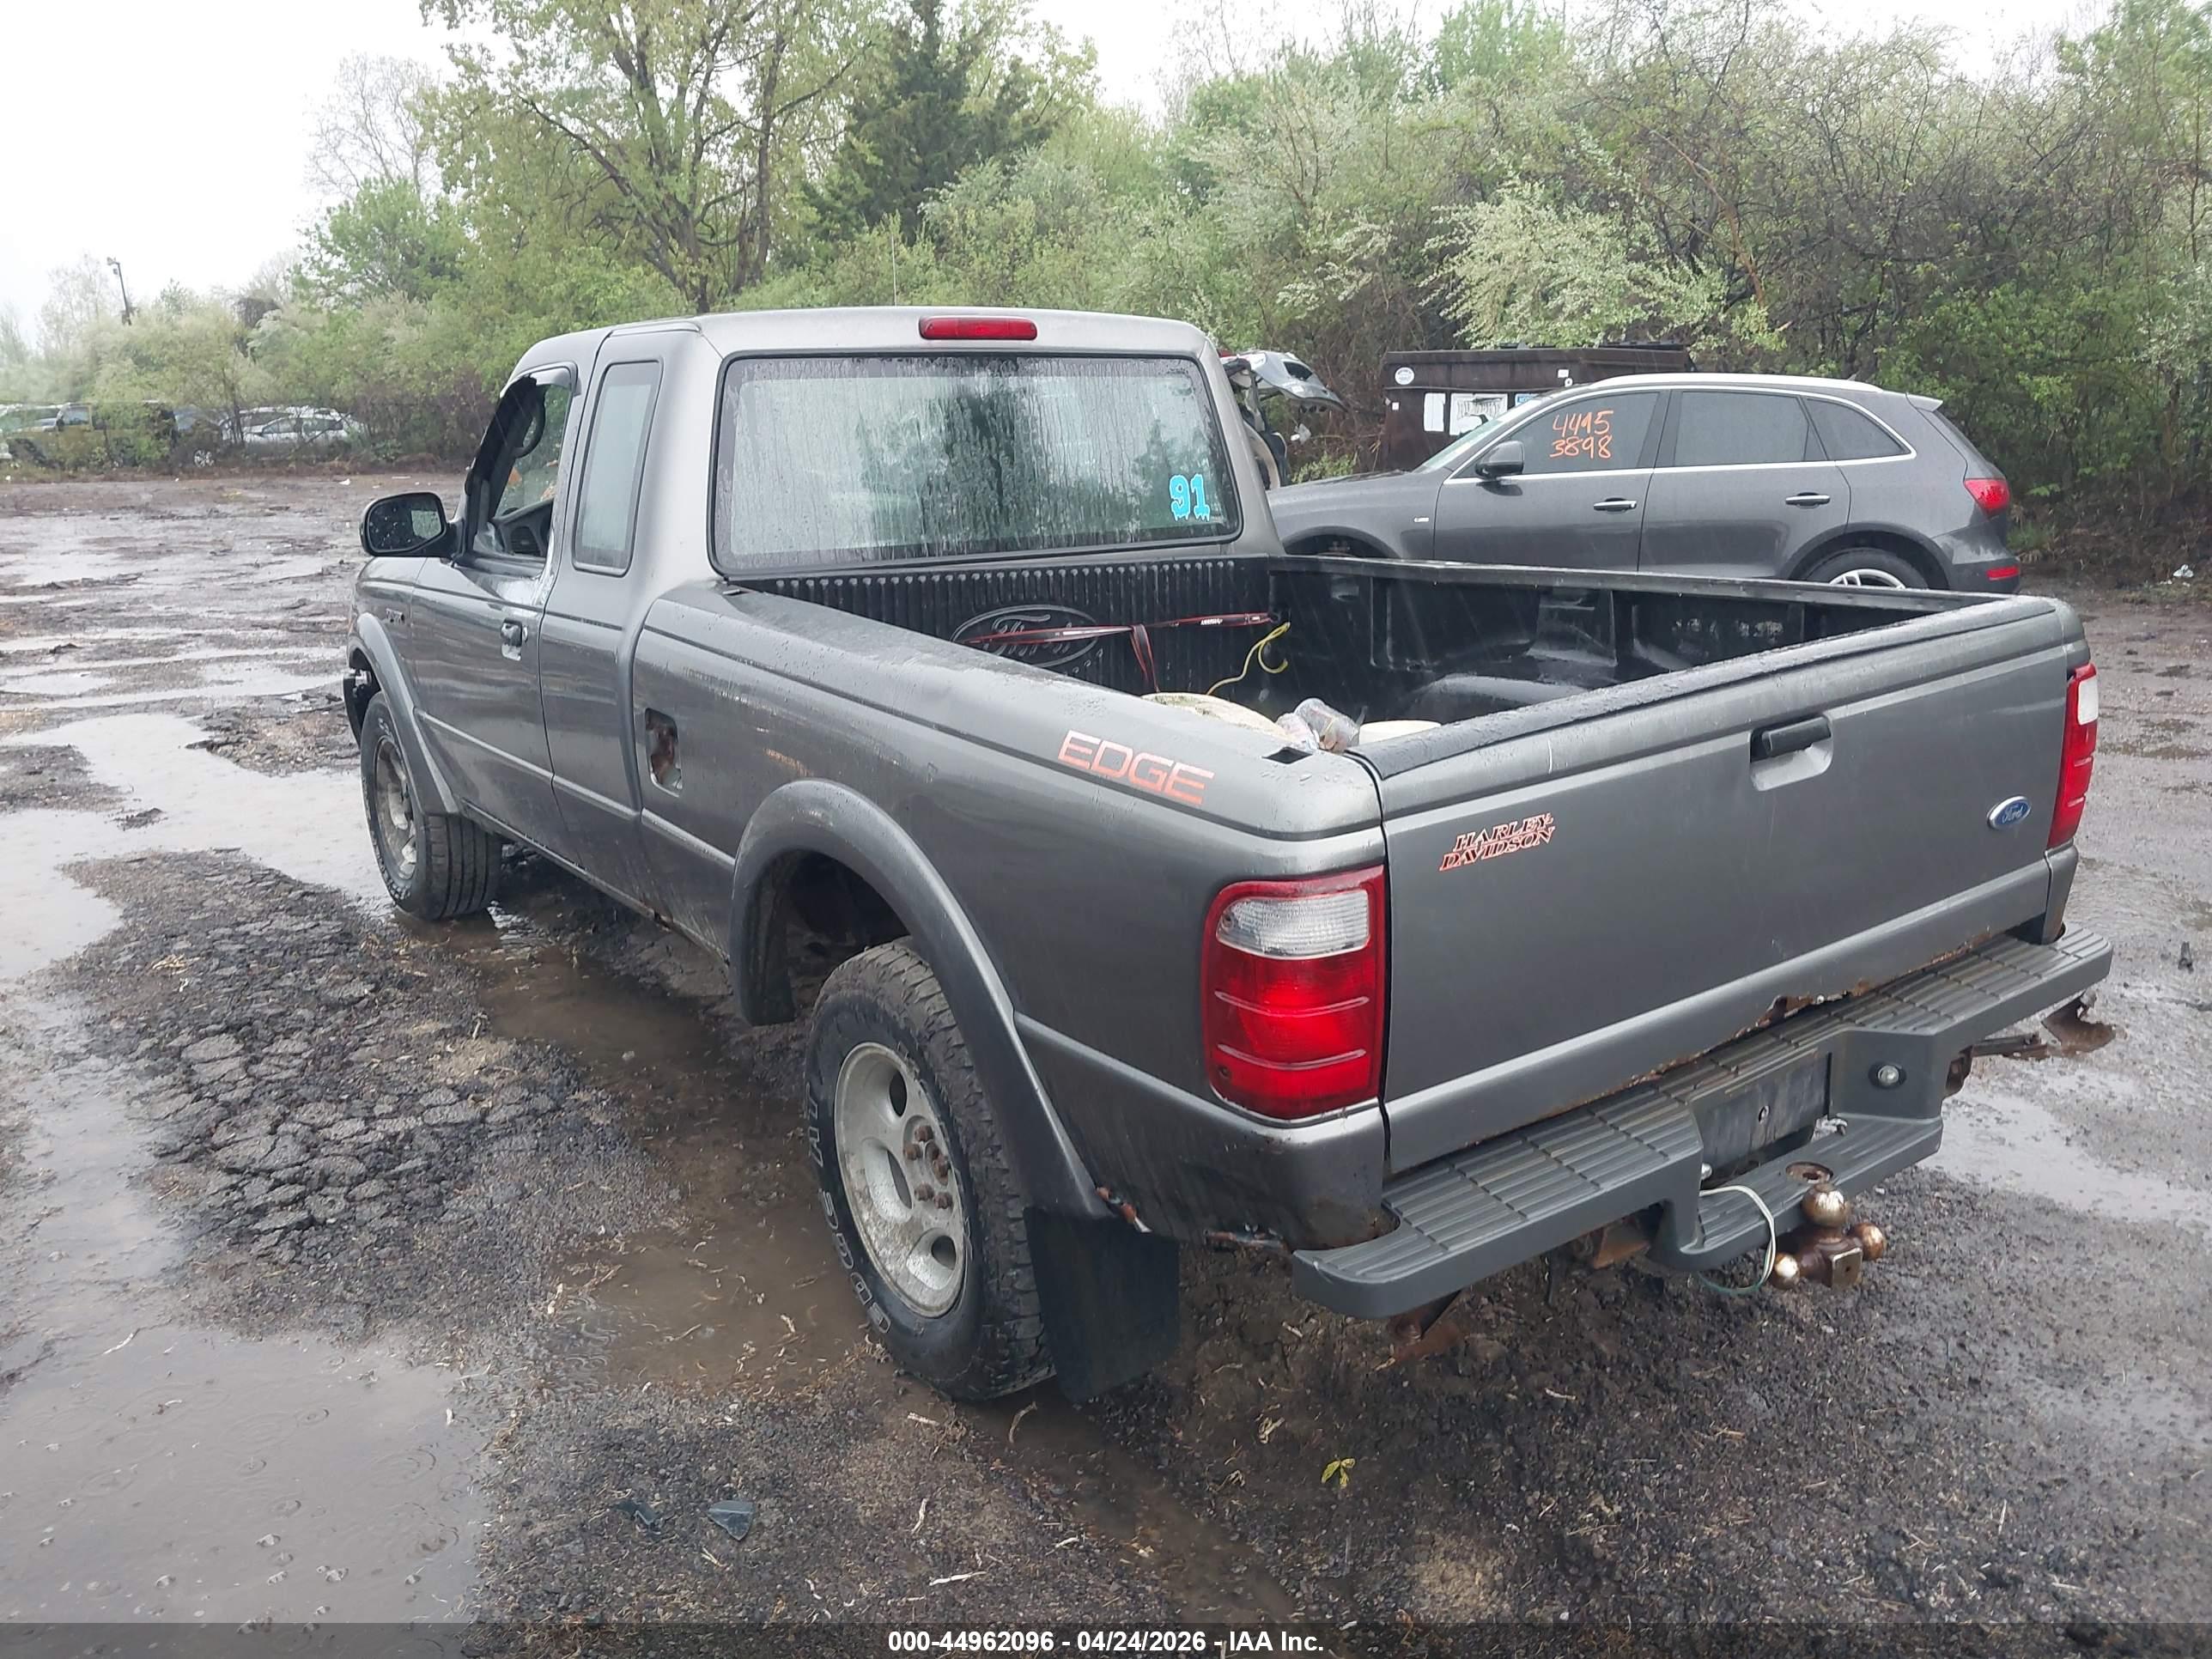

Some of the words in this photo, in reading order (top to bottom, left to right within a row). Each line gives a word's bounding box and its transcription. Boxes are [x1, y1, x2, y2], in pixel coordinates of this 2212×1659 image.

[1549, 434, 1613, 459] 3898
[1170, 473, 1211, 522] 91
[1057, 729, 1215, 805] EDGE
[1438, 826, 1556, 871] DAVIDSON
